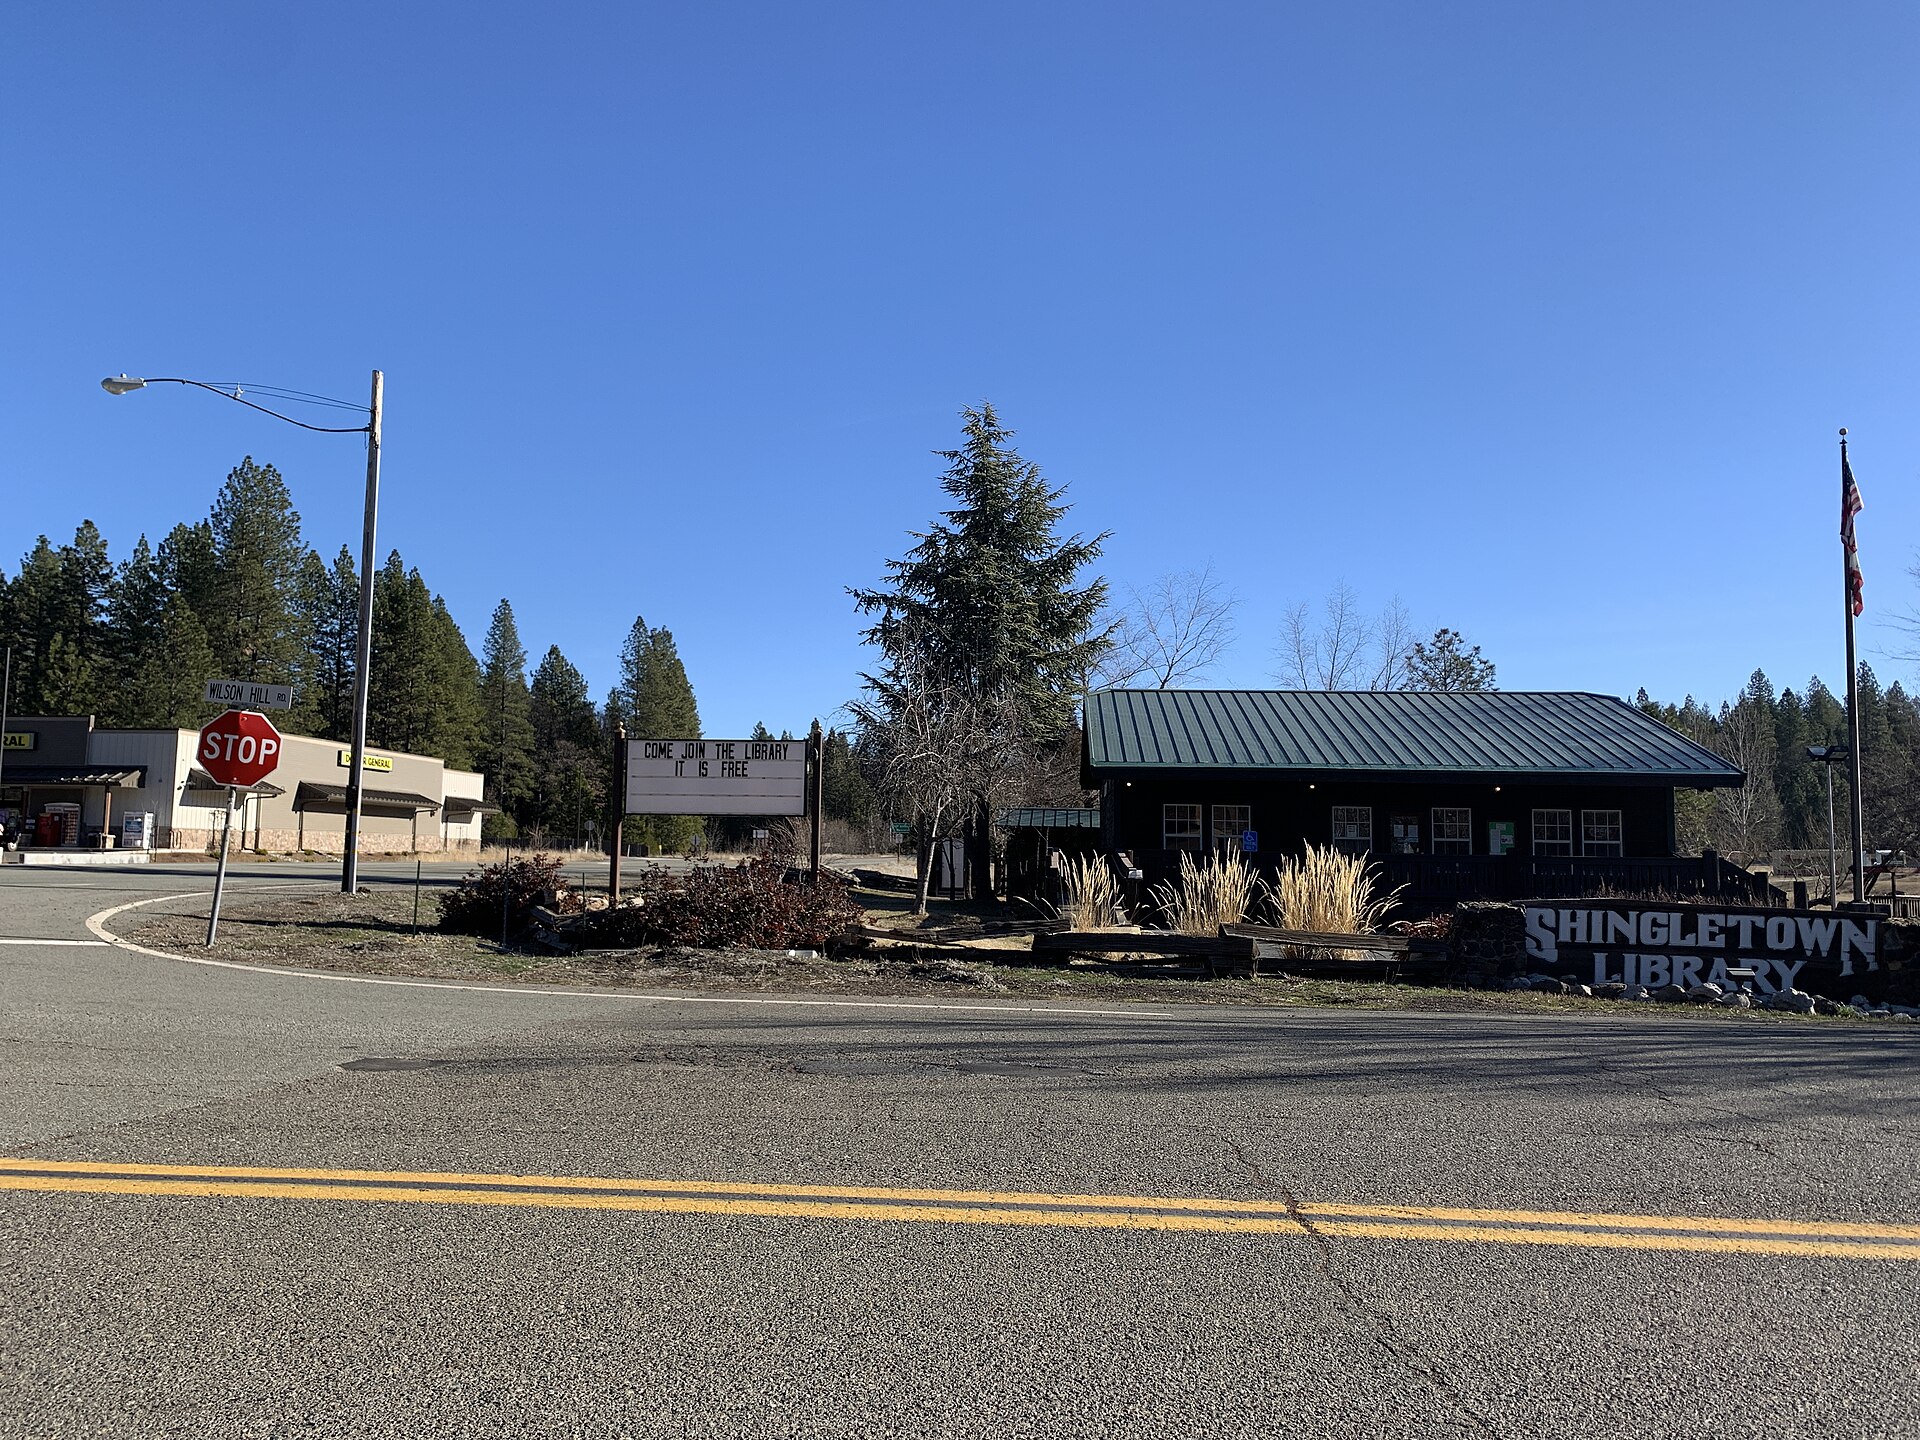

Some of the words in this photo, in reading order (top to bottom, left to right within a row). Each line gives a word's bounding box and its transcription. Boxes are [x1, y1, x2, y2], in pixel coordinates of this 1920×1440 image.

[209, 682, 243, 701] WILSON
[249, 687, 271, 704] HILL
[203, 732, 278, 765] STOP
[644, 742, 674, 759] COME
[681, 742, 706, 759] JOIN
[715, 743, 735, 760] THE
[744, 743, 789, 761] LIBRARY
[368, 757, 391, 769] GENERAL
[675, 760, 685, 777] IT
[698, 760, 709, 778] IS
[721, 760, 749, 778] FREE
[1525, 907, 1878, 977] SHINGLETOWN
[1593, 953, 1807, 995] LIBRARY
